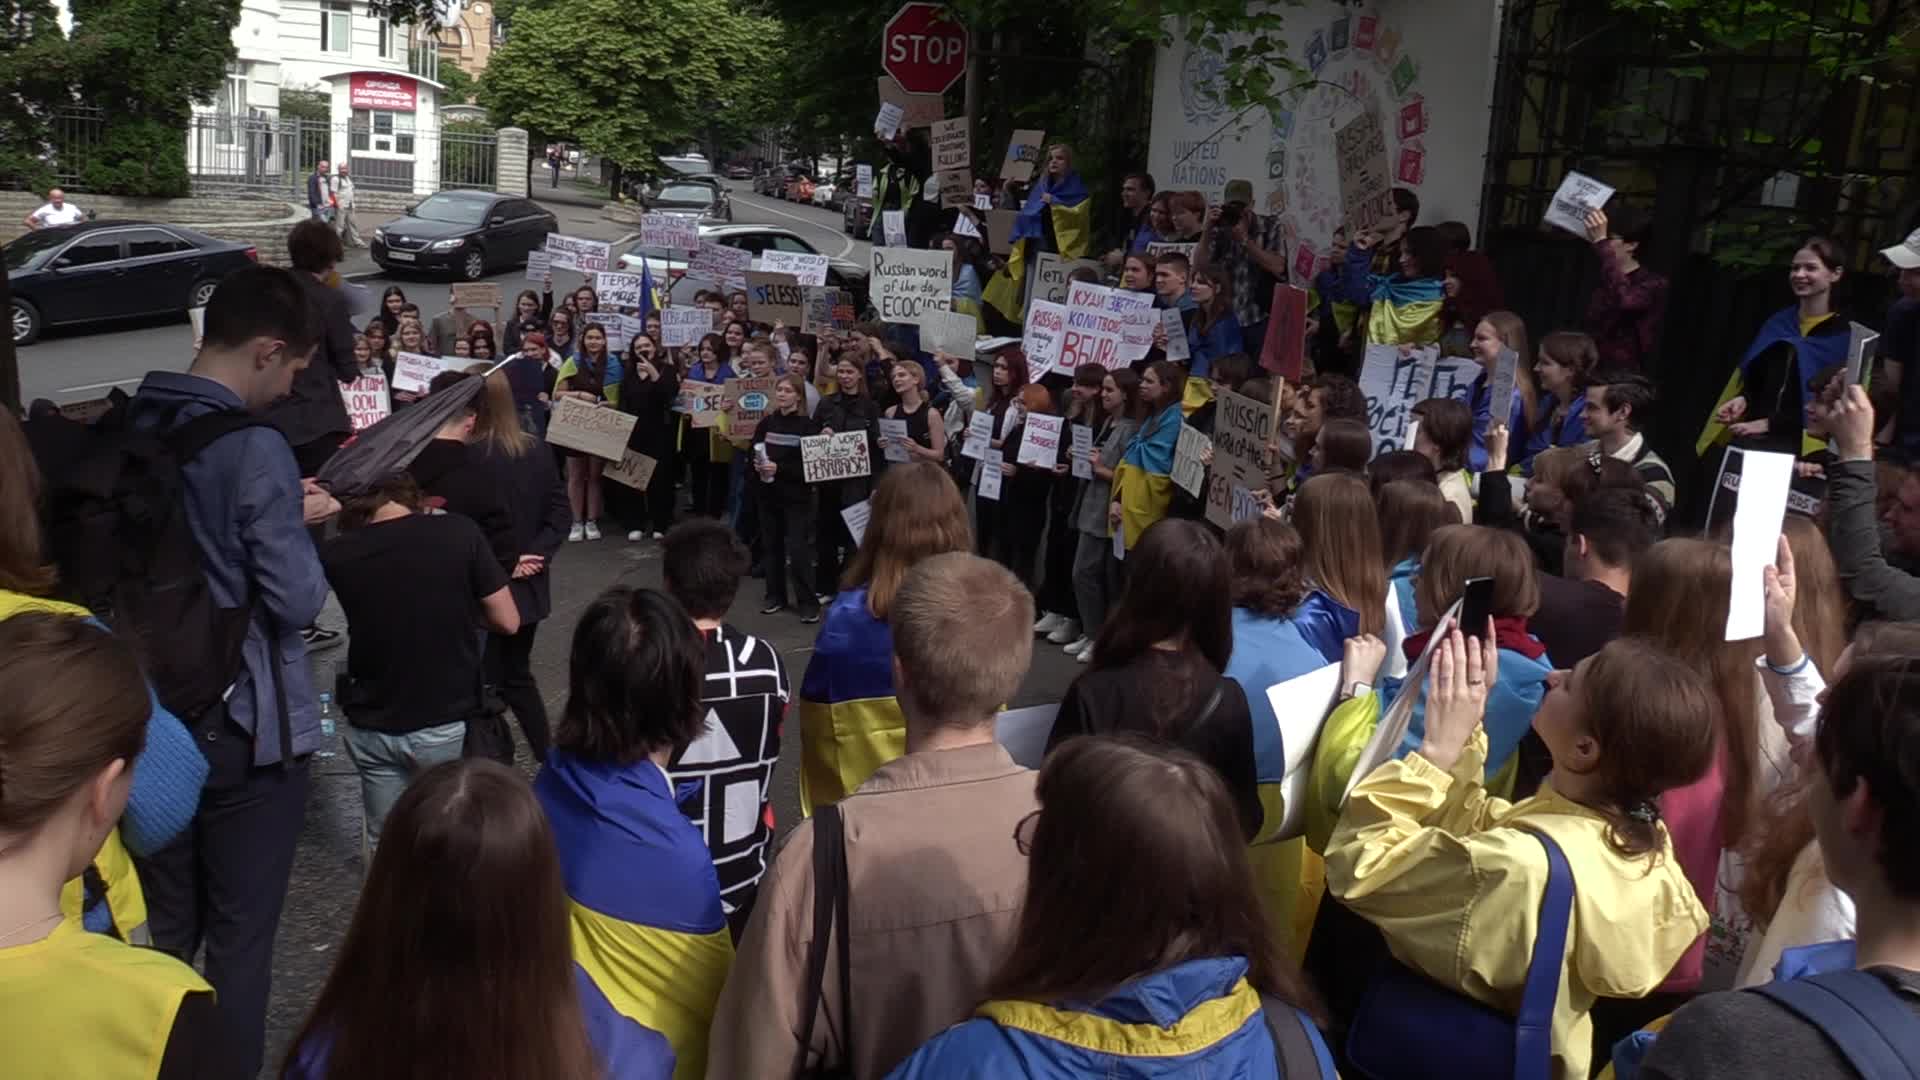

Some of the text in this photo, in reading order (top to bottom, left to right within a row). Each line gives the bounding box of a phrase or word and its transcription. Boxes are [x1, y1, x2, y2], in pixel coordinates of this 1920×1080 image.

[889, 35, 962, 64] STOP
[1174, 141, 1219, 160] UNITED
[1171, 168, 1227, 186] NATIONS
[873, 252, 948, 279] Russian word
[883, 279, 942, 298] of the day
